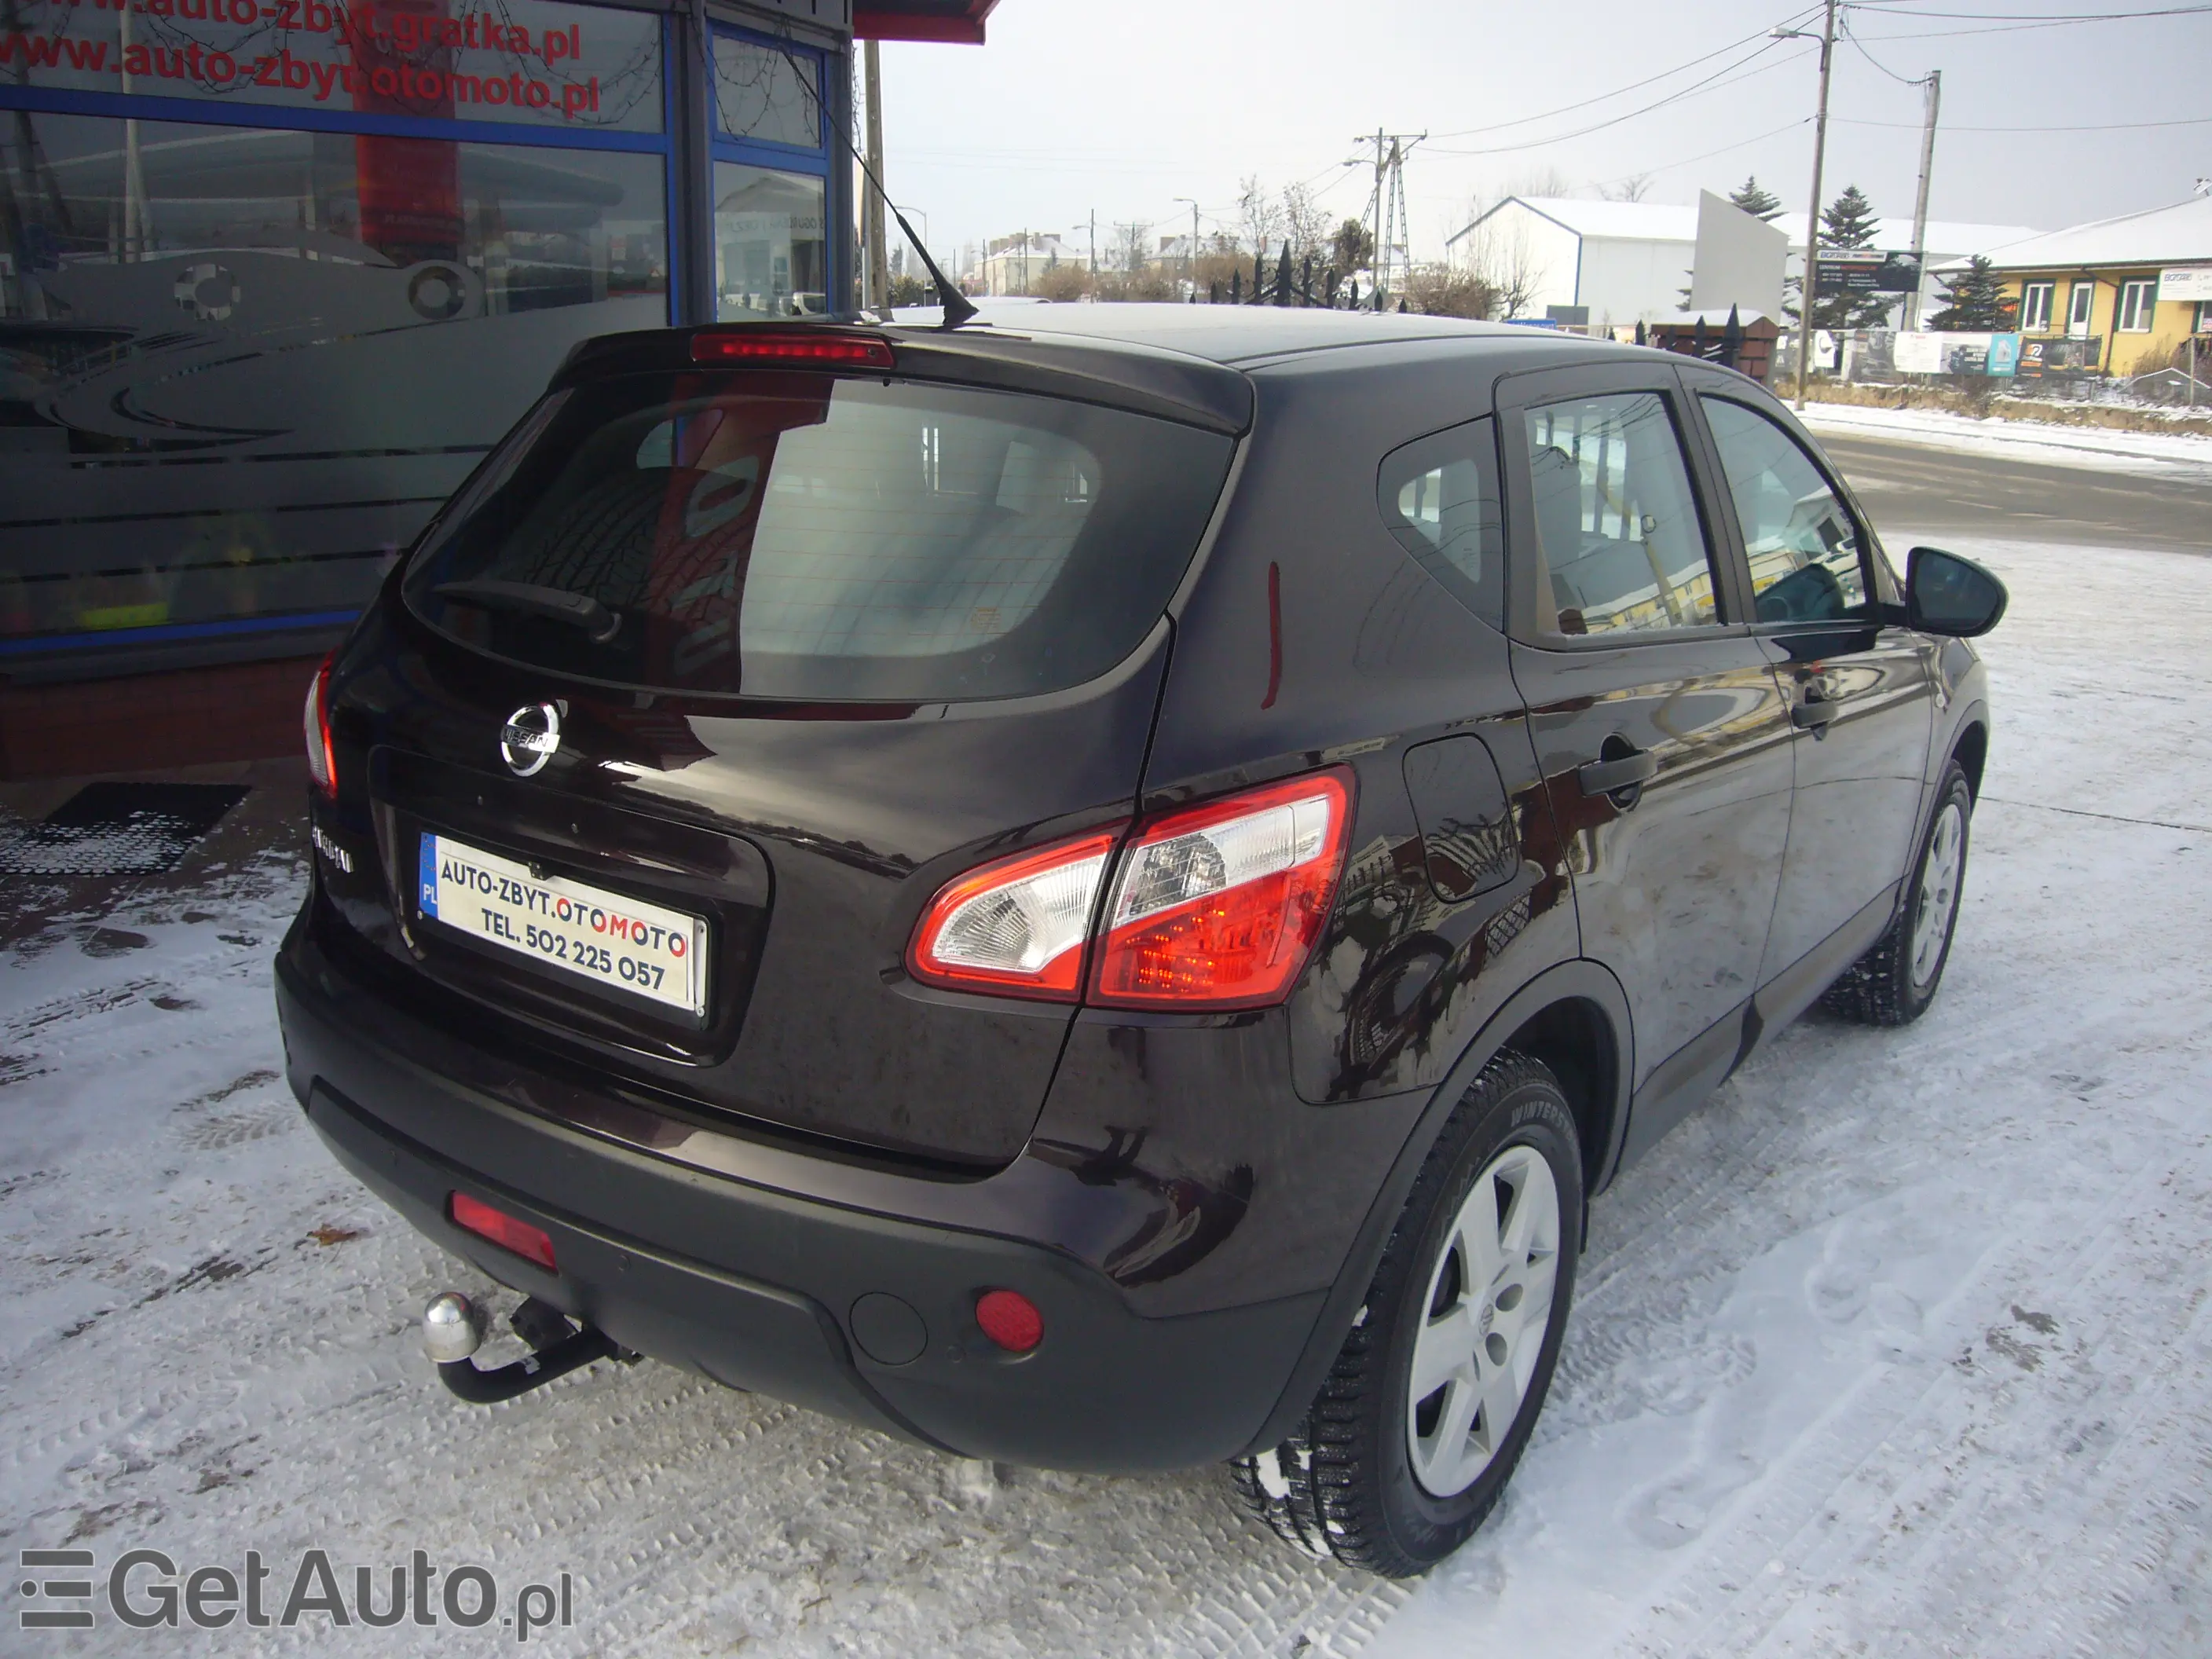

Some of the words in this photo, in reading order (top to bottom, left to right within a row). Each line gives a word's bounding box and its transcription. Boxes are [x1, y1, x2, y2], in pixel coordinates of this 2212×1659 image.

[424, 883, 438, 904] PL
[441, 858, 686, 958] AUTO-ZBYT.OTOMOTO
[482, 907, 521, 943] TEL.
[526, 924, 567, 959] 502
[573, 940, 612, 973] 225
[618, 956, 665, 990] 057
